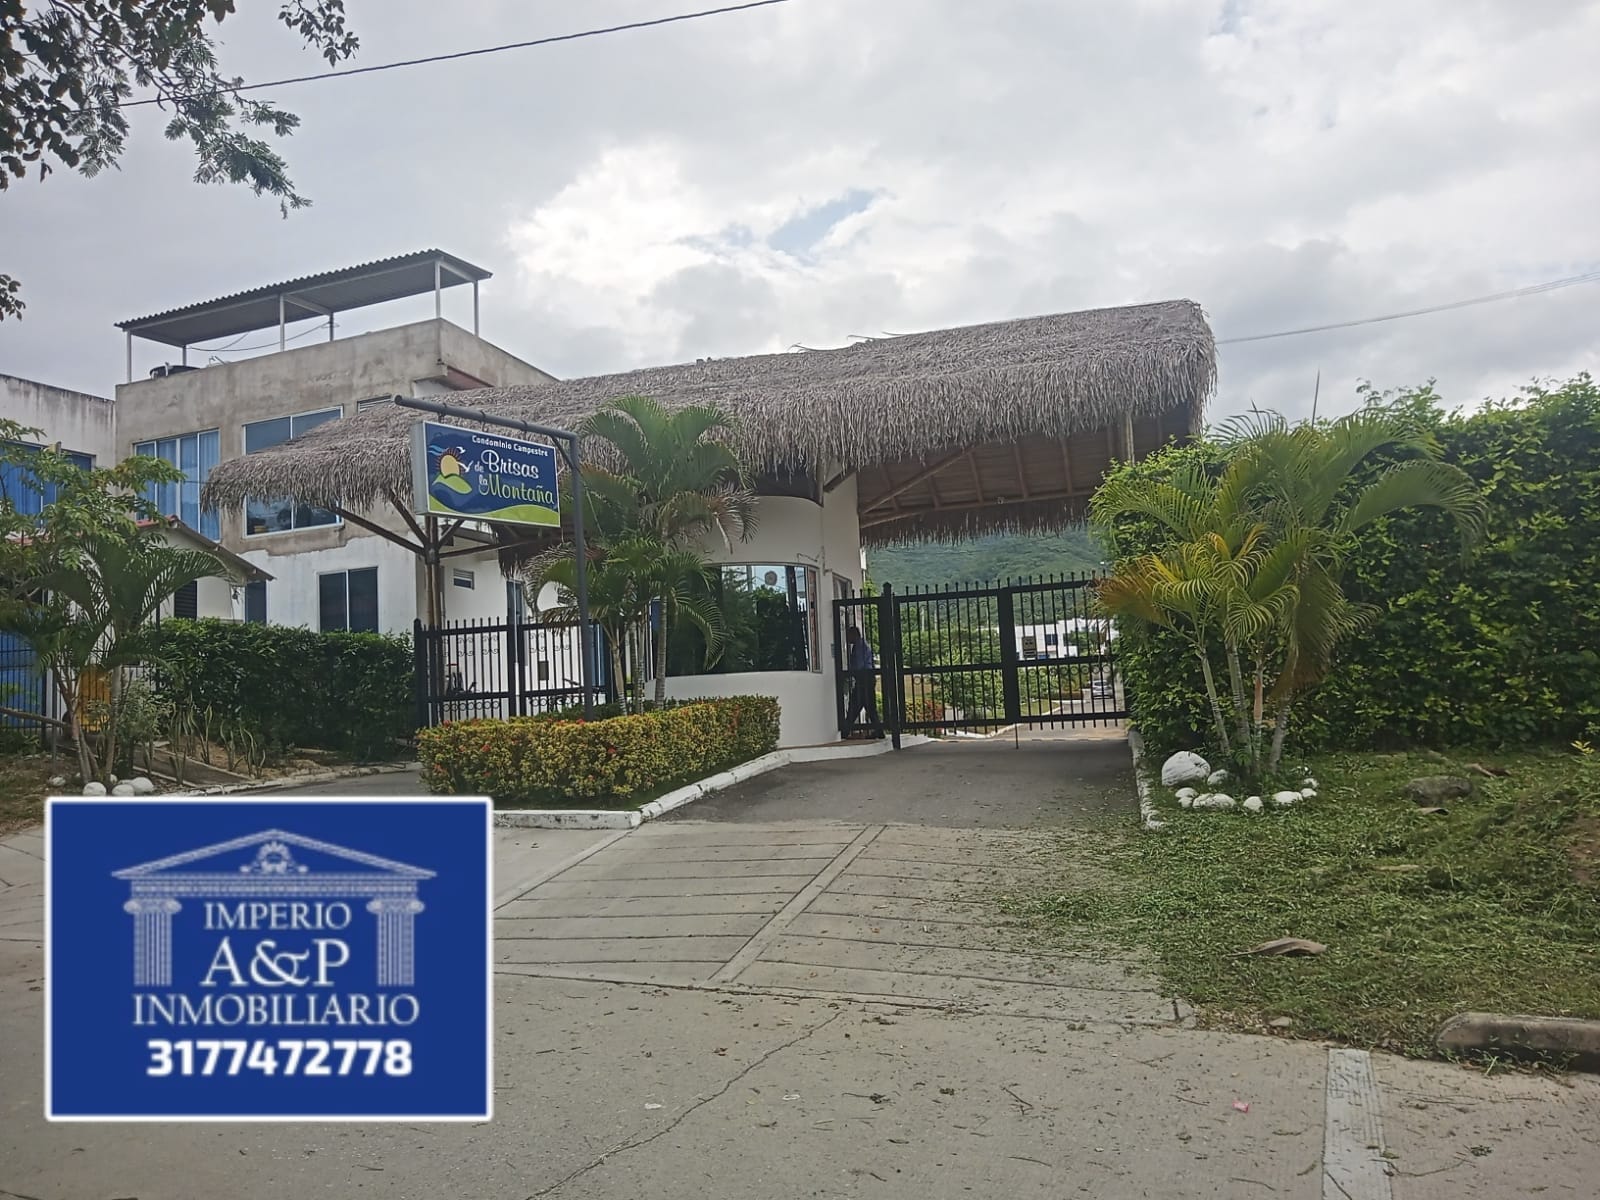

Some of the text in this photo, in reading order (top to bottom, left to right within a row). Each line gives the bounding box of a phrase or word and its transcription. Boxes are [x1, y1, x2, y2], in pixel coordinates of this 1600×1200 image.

[472, 435, 548, 457] Condominio Campestre
[474, 450, 539, 479] de Brisas
[478, 474, 555, 505] la Montaña
